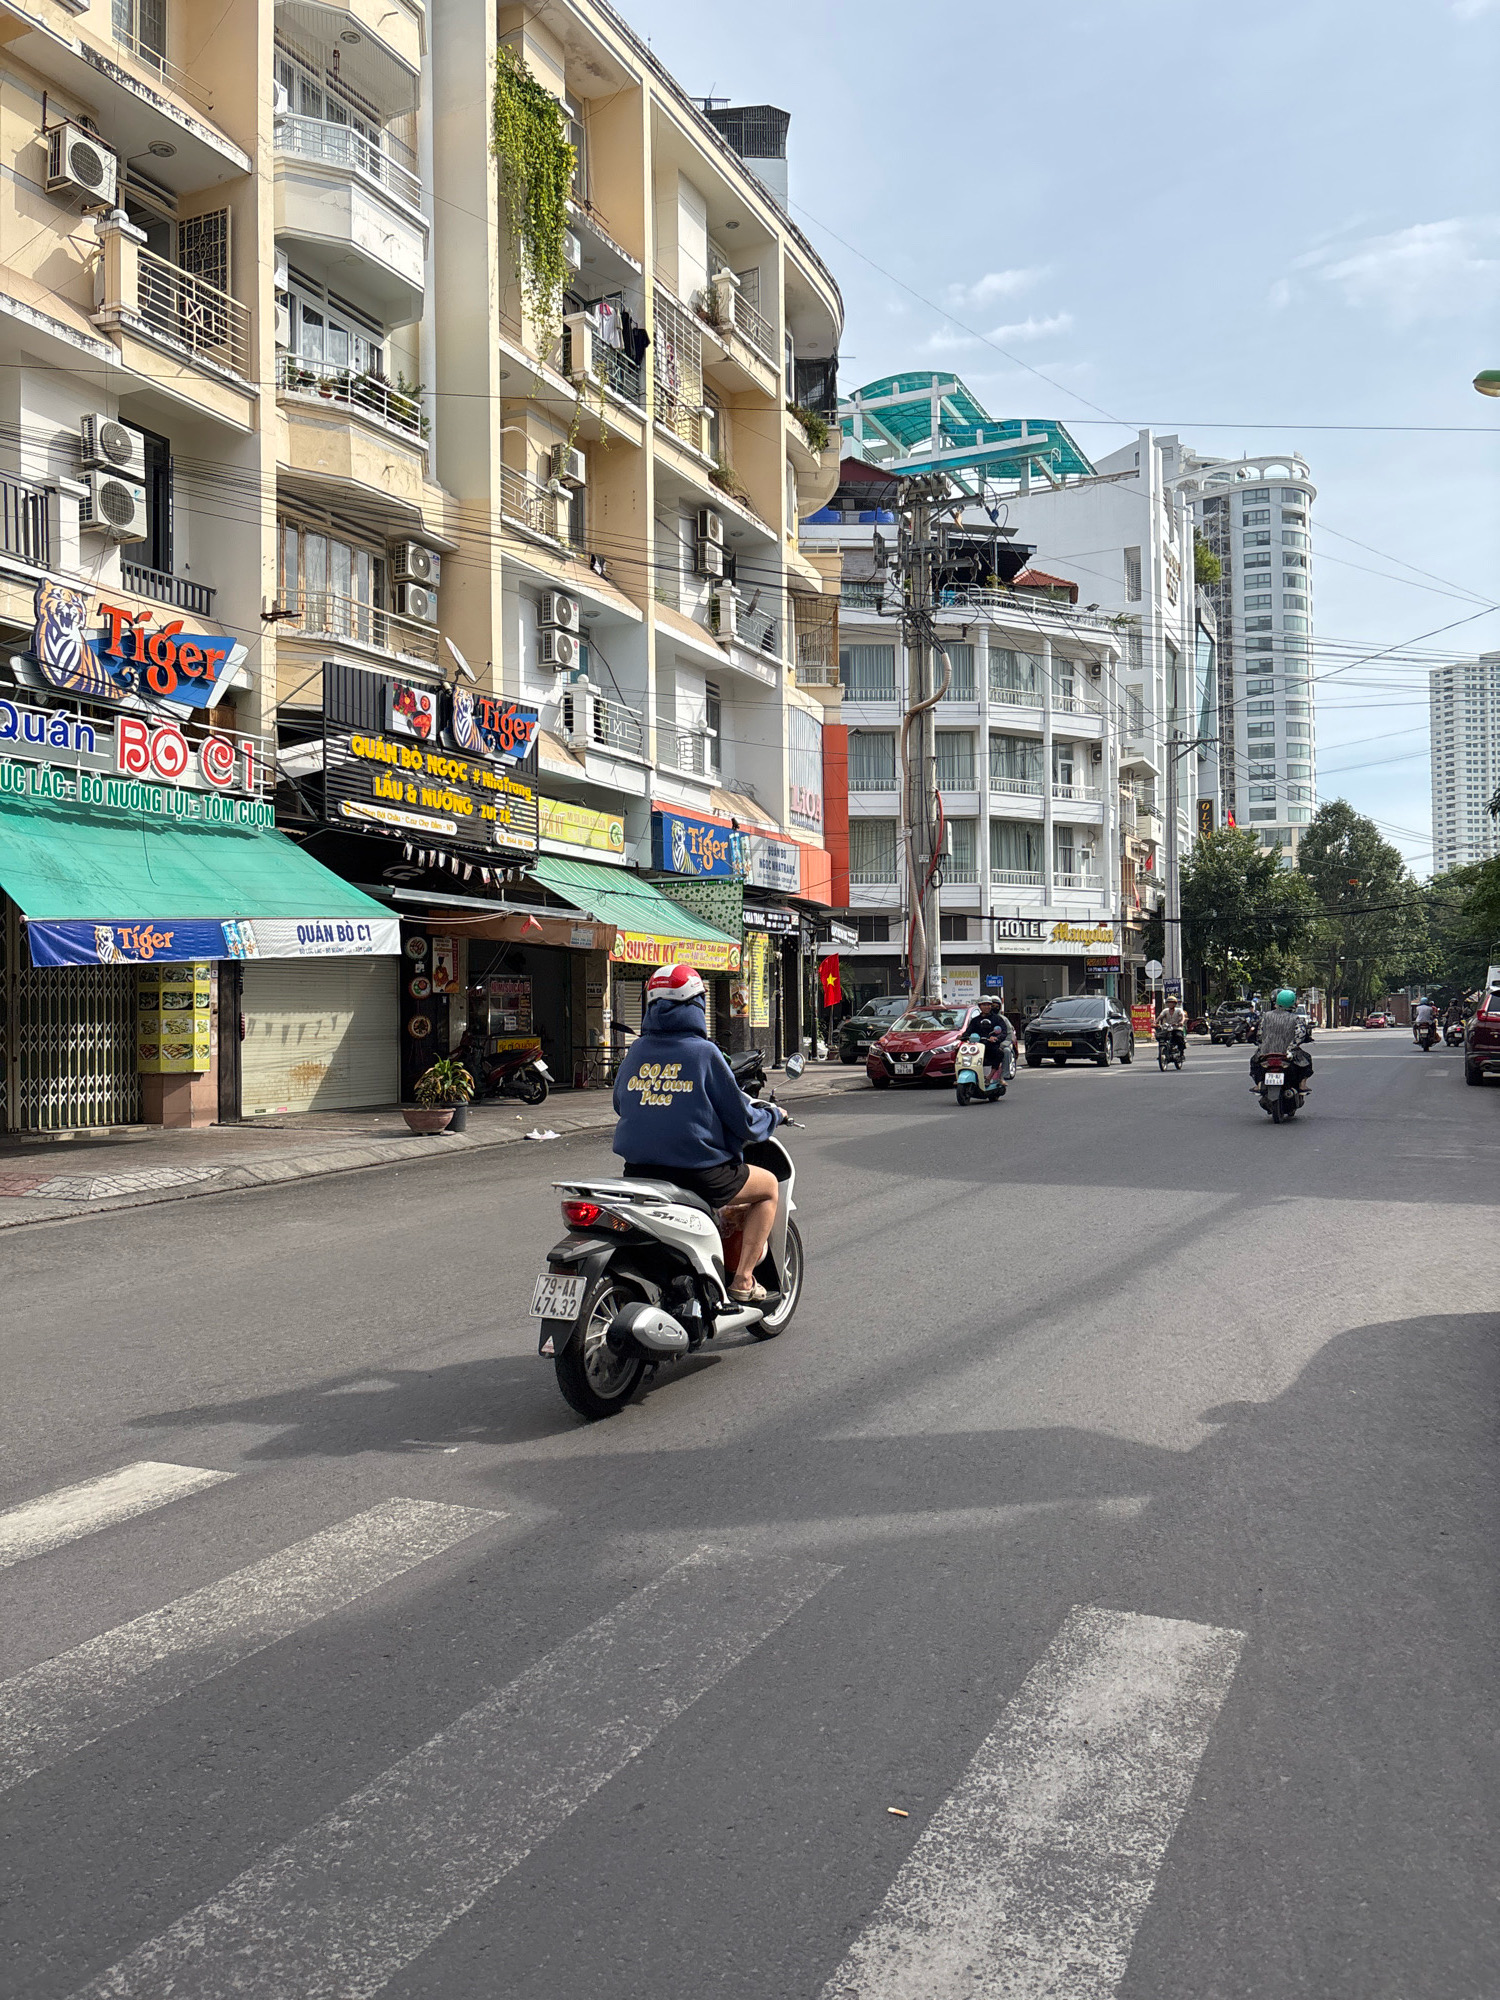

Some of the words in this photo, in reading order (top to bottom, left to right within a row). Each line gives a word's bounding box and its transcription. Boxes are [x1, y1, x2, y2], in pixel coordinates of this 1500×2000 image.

[98, 603, 226, 694] Tiger
[0, 700, 95, 753] Quán
[117, 715, 190, 779] BÒ
[479, 698, 535, 751] Tiger
[351, 735, 398, 764] QUÁN
[401, 744, 423, 770] BÒ
[426, 754, 468, 784] NGỌC
[30, 761, 65, 800] LẮC
[80, 771, 103, 805] BÒ
[107, 779, 162, 812] NƯỚNG
[166, 789, 190, 821] LỤI
[204, 792, 234, 822] TÔM
[239, 800, 275, 831] CUỘN
[406, 783, 418, 803] &
[421, 786, 473, 815] NƯỚNG
[688, 827, 728, 870] Tiger
[117, 925, 174, 959] Tiger
[297, 920, 334, 945] QUÁN
[336, 920, 354, 942] BÒ
[357, 924, 372, 942] C1
[999, 920, 1047, 938] HOTEL
[627, 1076, 662, 1091] One's
[662, 1079, 693, 1092] own
[639, 1090, 673, 1106] Pace
[542, 1277, 577, 1297] 79-AA
[535, 1296, 577, 1317] 474.32
